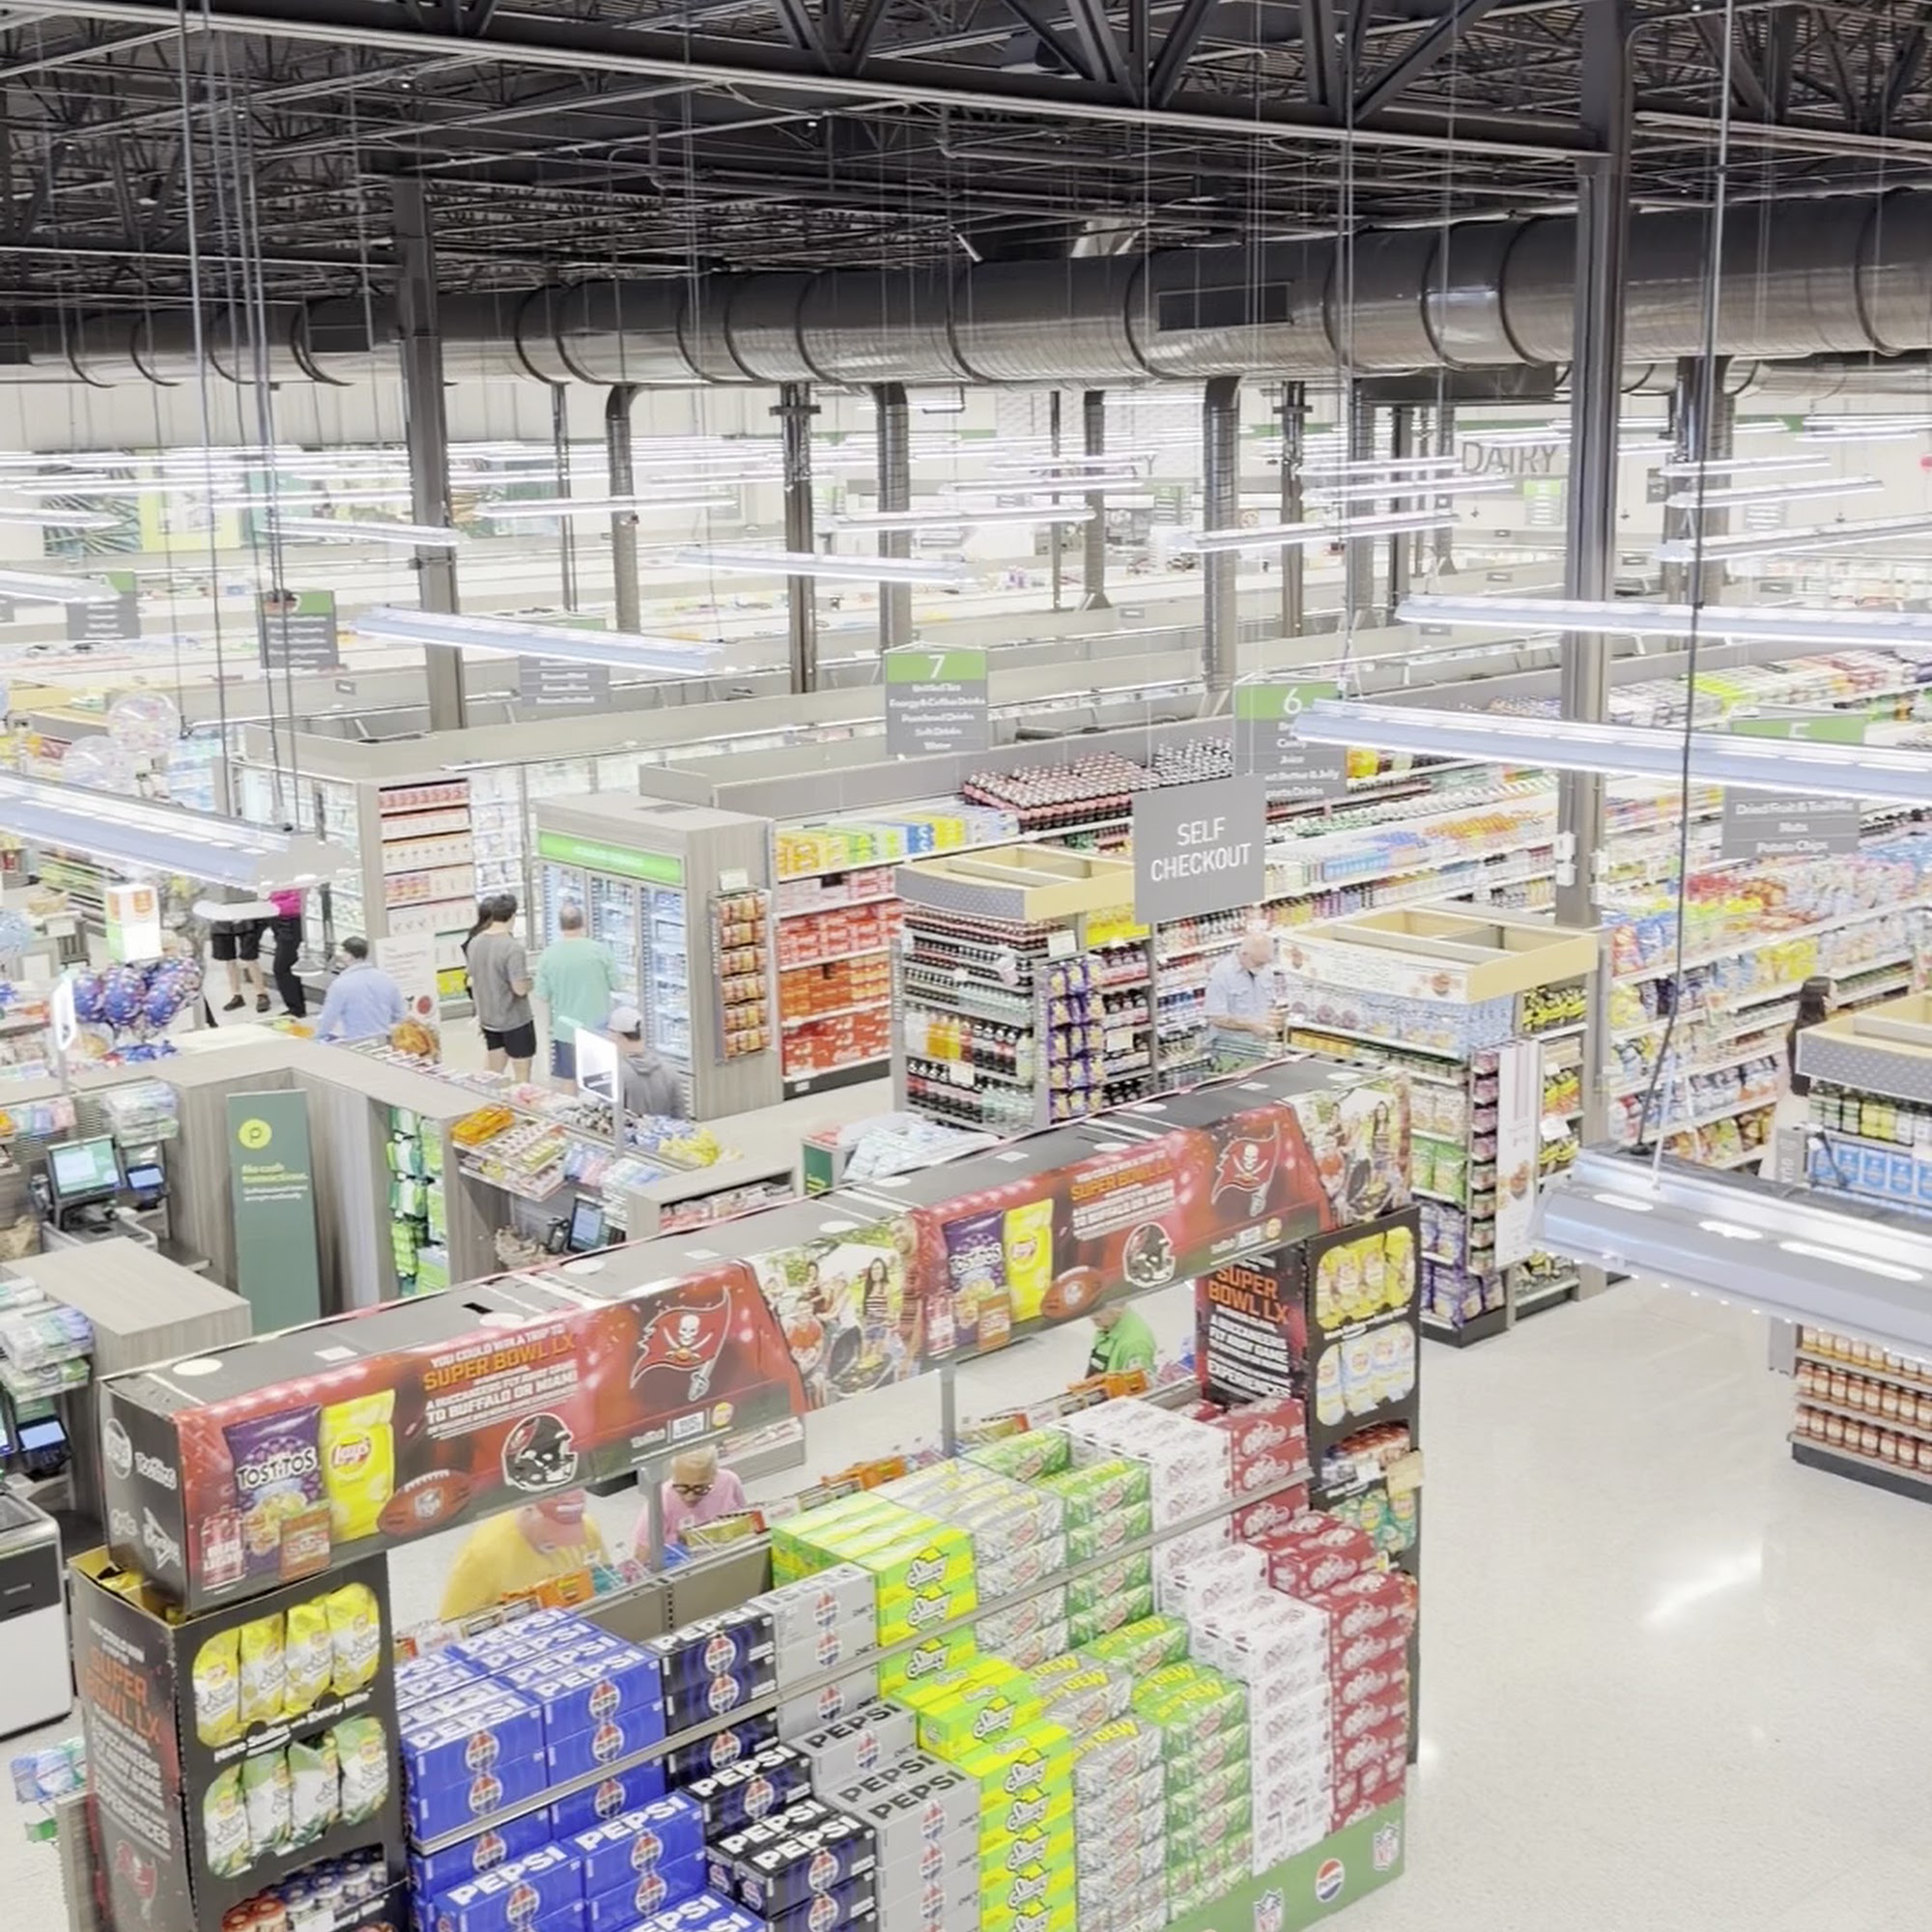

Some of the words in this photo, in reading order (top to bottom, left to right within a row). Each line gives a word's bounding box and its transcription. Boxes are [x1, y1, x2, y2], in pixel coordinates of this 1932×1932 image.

[1462, 441, 1559, 473] DAIRY
[928, 654, 945, 678] 7
[1284, 688, 1302, 715] 6
[1280, 755, 1304, 765] Juice
[1177, 817, 1226, 846] SELF
[1151, 843, 1251, 882] CHECKOUT
[1208, 1278, 1261, 1320] BOWL
[1262, 1296, 1291, 1325] LX
[1215, 1265, 1279, 1300] SUPER
[423, 1356, 490, 1391] SUPER
[494, 1342, 549, 1372] BOWL
[552, 1332, 577, 1357] LX
[426, 1407, 446, 1425] TO
[447, 1389, 512, 1418] BUFFALO
[513, 1383, 533, 1399] OR
[459, 1608, 569, 1654] PEPSI
[484, 1623, 594, 1667] PEPSI
[649, 1605, 760, 1652] PEPSI
[91, 1645, 148, 1706] SUPER
[506, 1635, 618, 1683] PEPSI
[534, 1648, 646, 1696] PEPSI
[395, 1667, 474, 1706] EPSI
[406, 1696, 528, 1747] PEPSI
[806, 1702, 903, 1749] PEPSI
[688, 1744, 799, 1797] PEPSI
[838, 1753, 938, 1804] PEPSI
[868, 1770, 967, 1820] PEPSI
[575, 1795, 690, 1852] PEPSI
[718, 1799, 827, 1855] PEPSI
[752, 1814, 863, 1870] PEPSI
[447, 1845, 568, 1905] PEPSI
